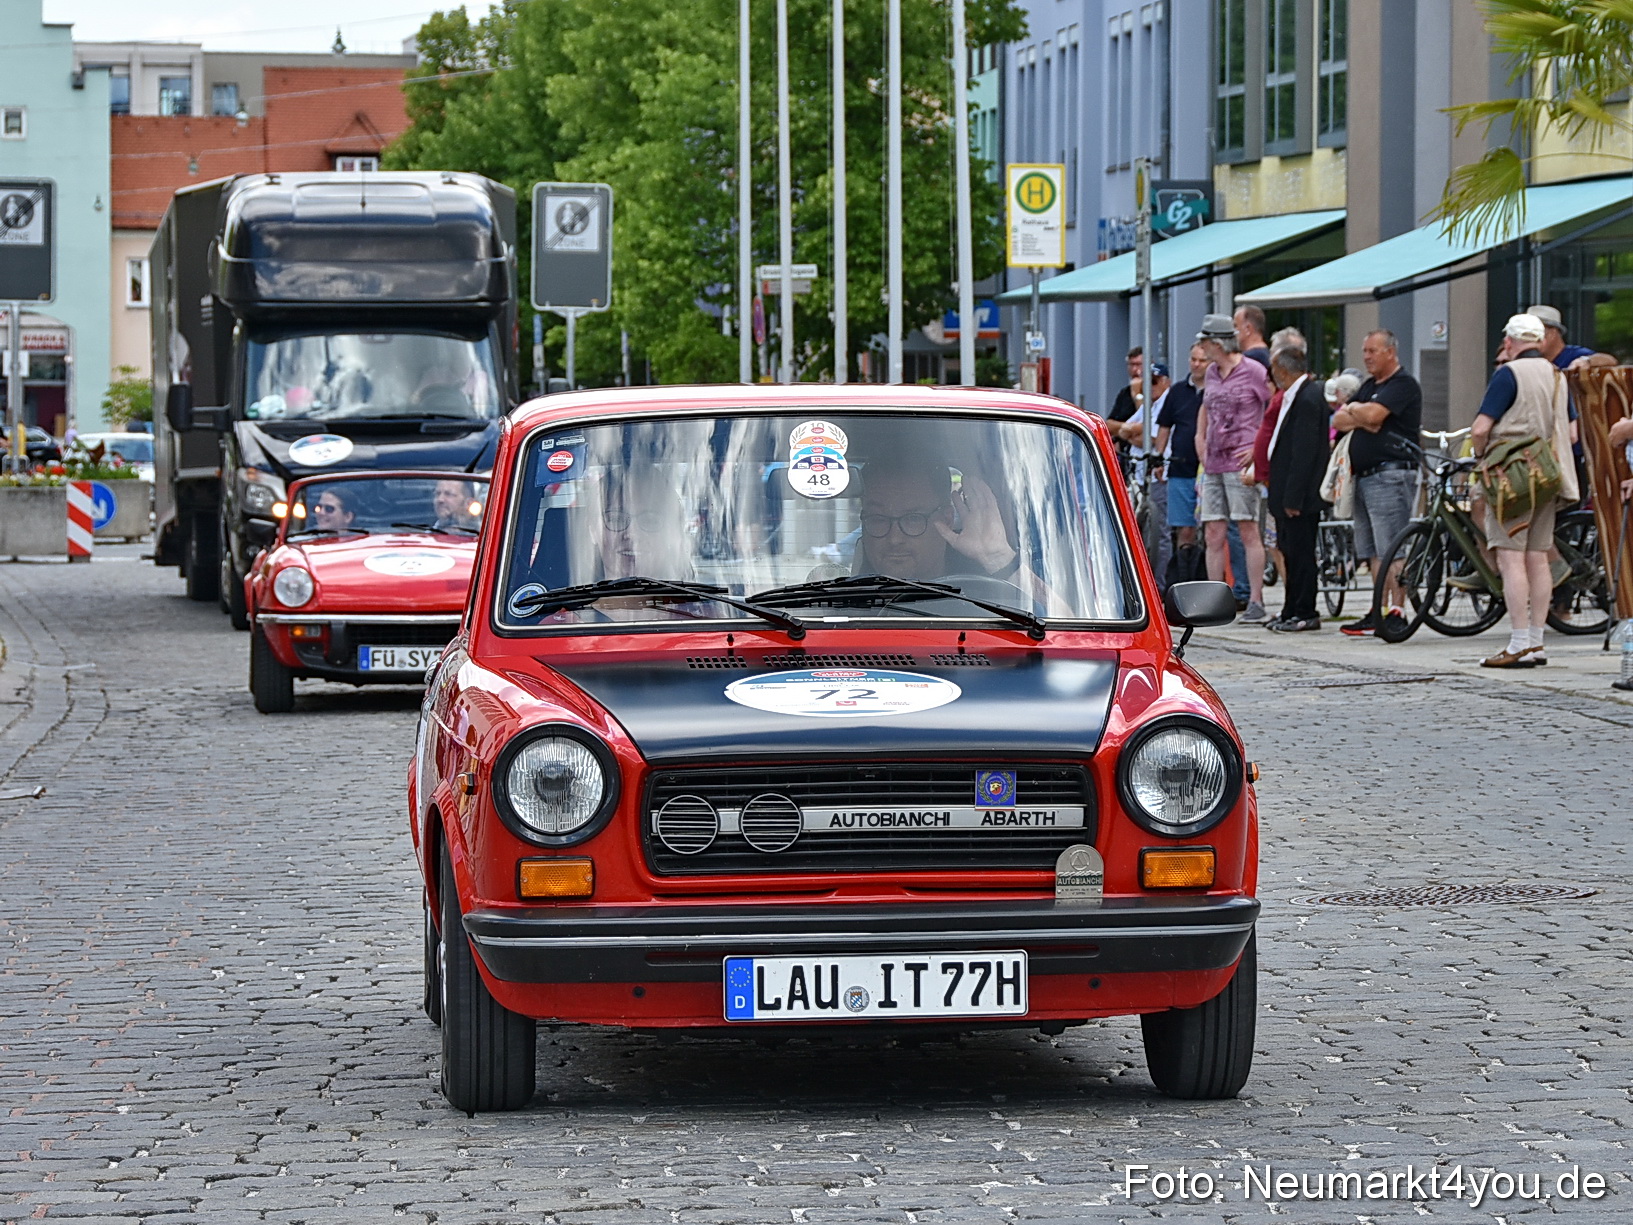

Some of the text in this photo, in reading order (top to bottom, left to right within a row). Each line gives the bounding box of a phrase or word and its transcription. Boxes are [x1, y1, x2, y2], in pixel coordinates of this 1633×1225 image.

[1167, 199, 1192, 231] G2
[807, 473, 830, 486] 48
[371, 650, 395, 667] FÜ
[809, 688, 879, 700] 72
[829, 811, 1056, 827] AUTOBIANCHI ABARTH
[756, 960, 1021, 1010] LAU IT 77H
[734, 995, 746, 1009] D
